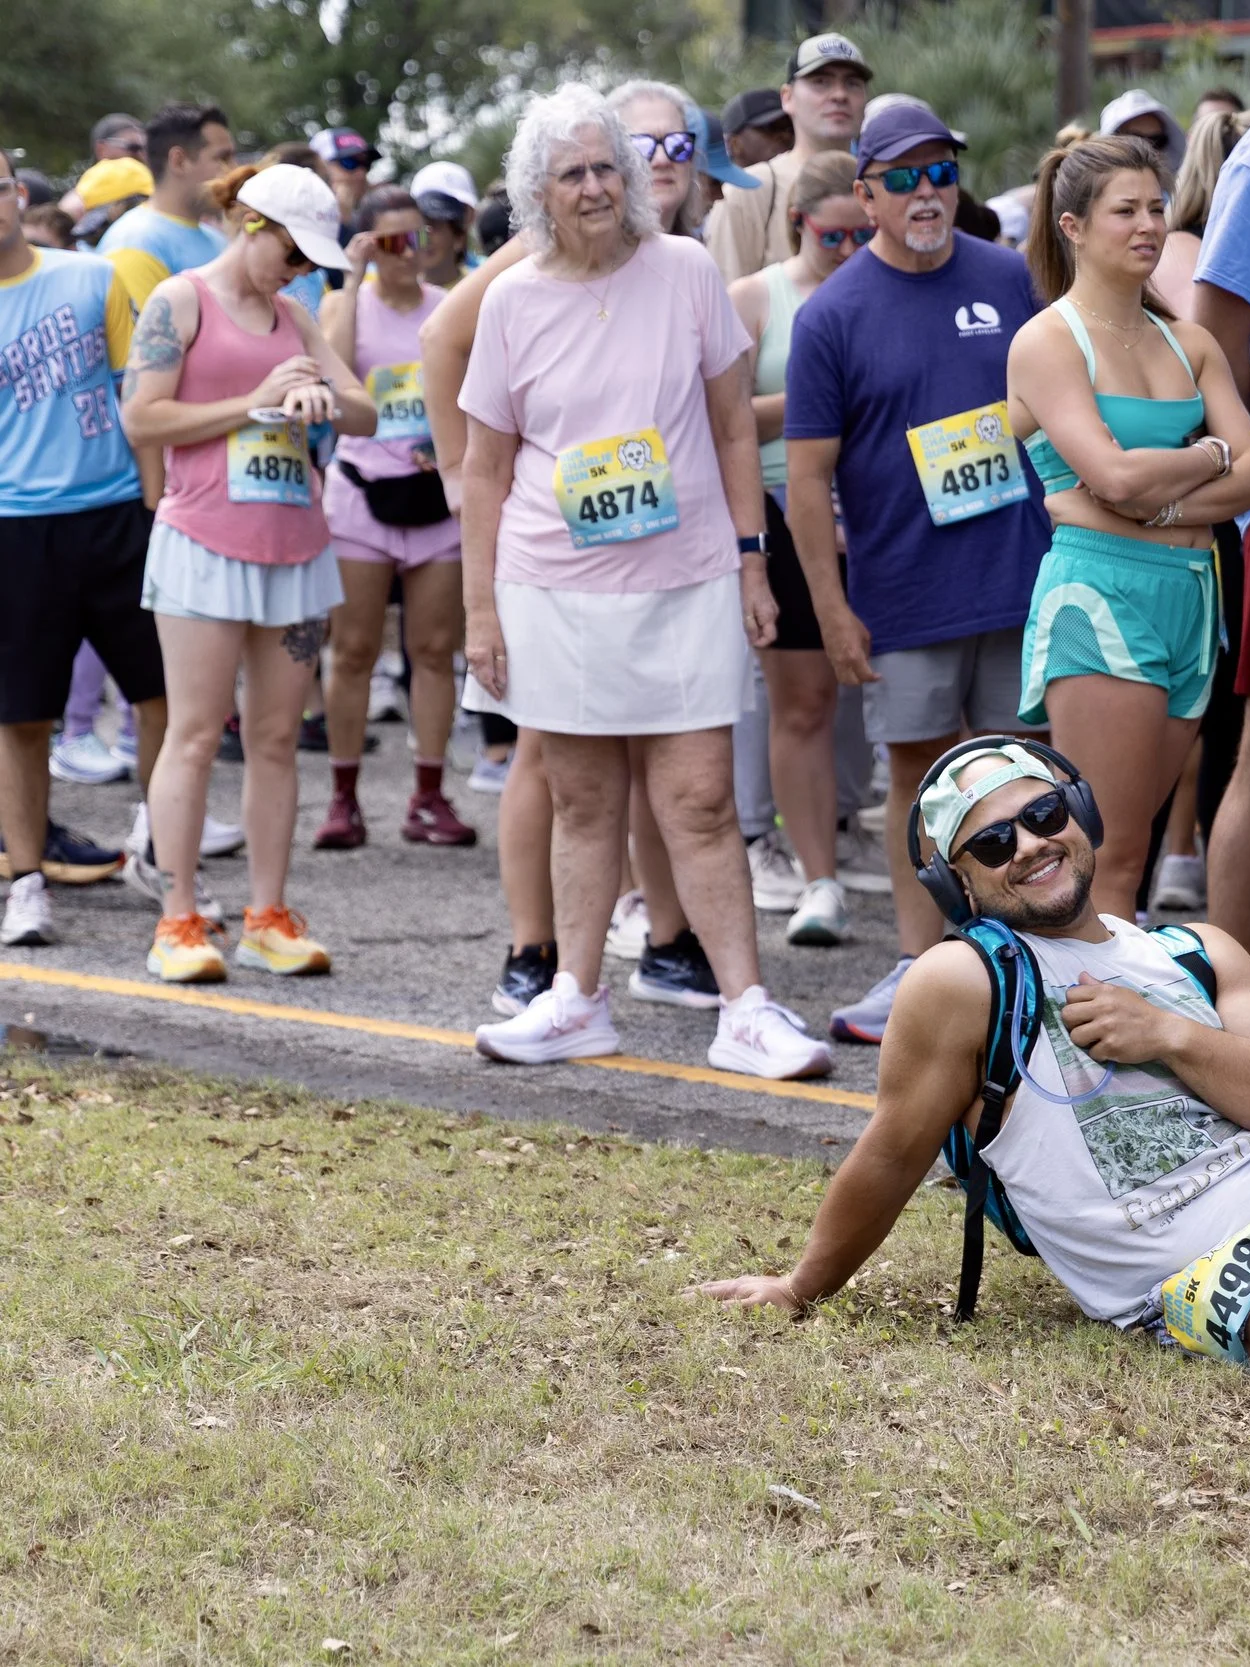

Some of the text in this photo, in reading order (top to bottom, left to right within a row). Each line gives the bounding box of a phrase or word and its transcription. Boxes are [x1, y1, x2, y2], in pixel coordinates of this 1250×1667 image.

[381, 398, 425, 420] 450
[950, 439, 967, 452] 5K
[244, 454, 305, 486] 4878
[589, 464, 608, 479] 5K
[941, 452, 1010, 496] 4873
[578, 479, 659, 524] 4874
[1117, 1152, 1233, 1231] FIELD OF
[1163, 1290, 1175, 1327] RUN
[1182, 1276, 1201, 1340] RUN 5K
